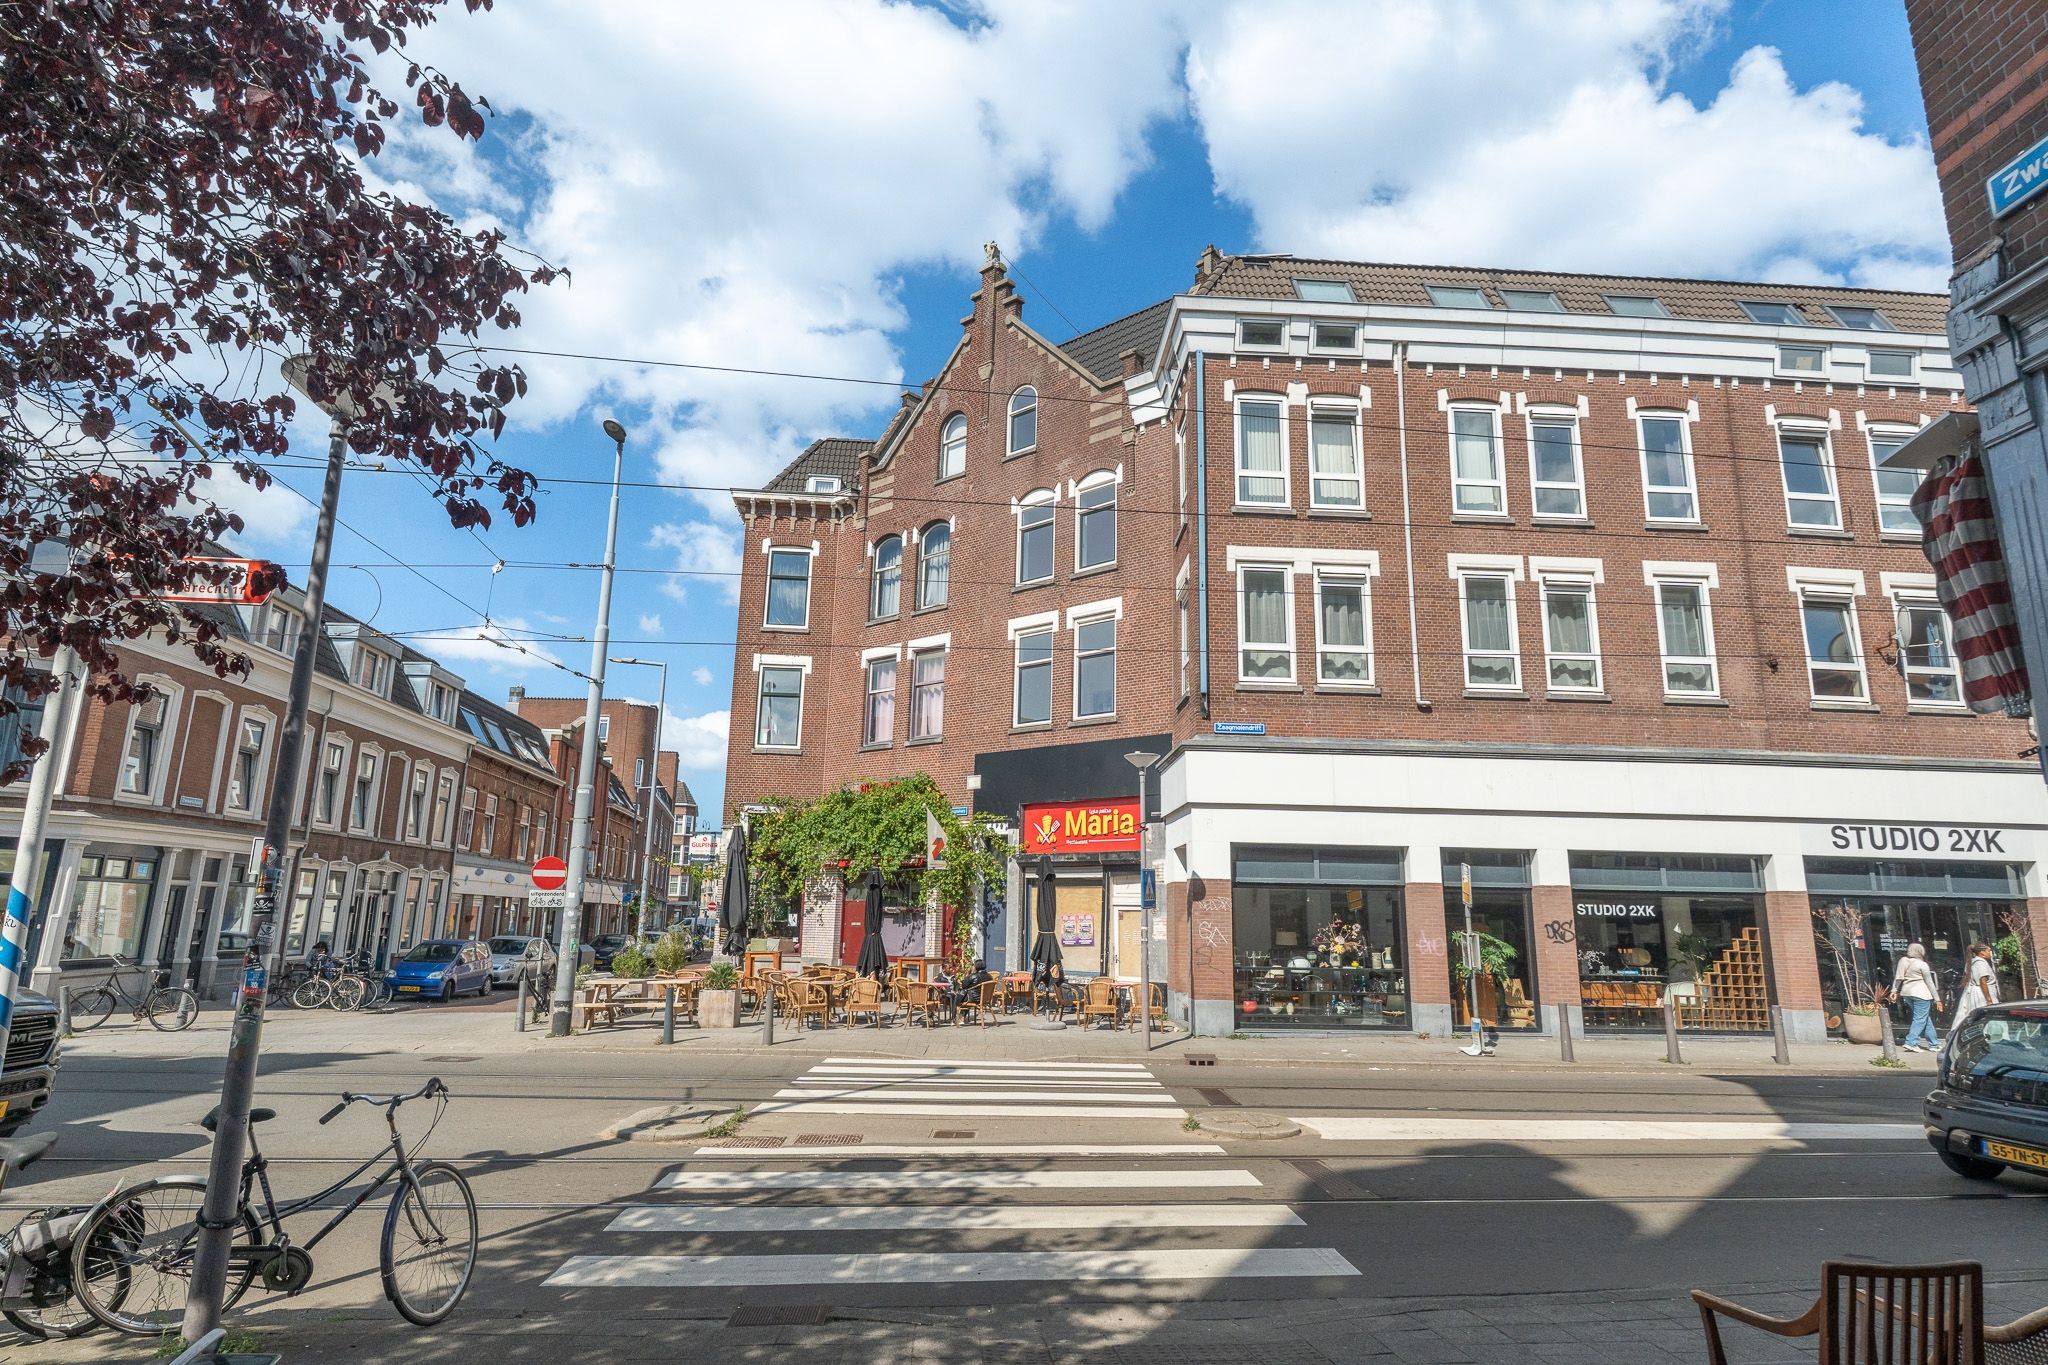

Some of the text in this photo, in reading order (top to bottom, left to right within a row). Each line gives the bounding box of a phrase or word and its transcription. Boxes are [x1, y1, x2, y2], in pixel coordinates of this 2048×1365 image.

[1216, 724, 1262, 732] Zaagmolendrift
[1065, 808, 1134, 837] Maria
[1831, 825, 2006, 853] STUDIO 2XK
[1576, 903, 1656, 917] STUDIO 2XK
[1991, 1144, 2047, 1166] 55-TN-ST
